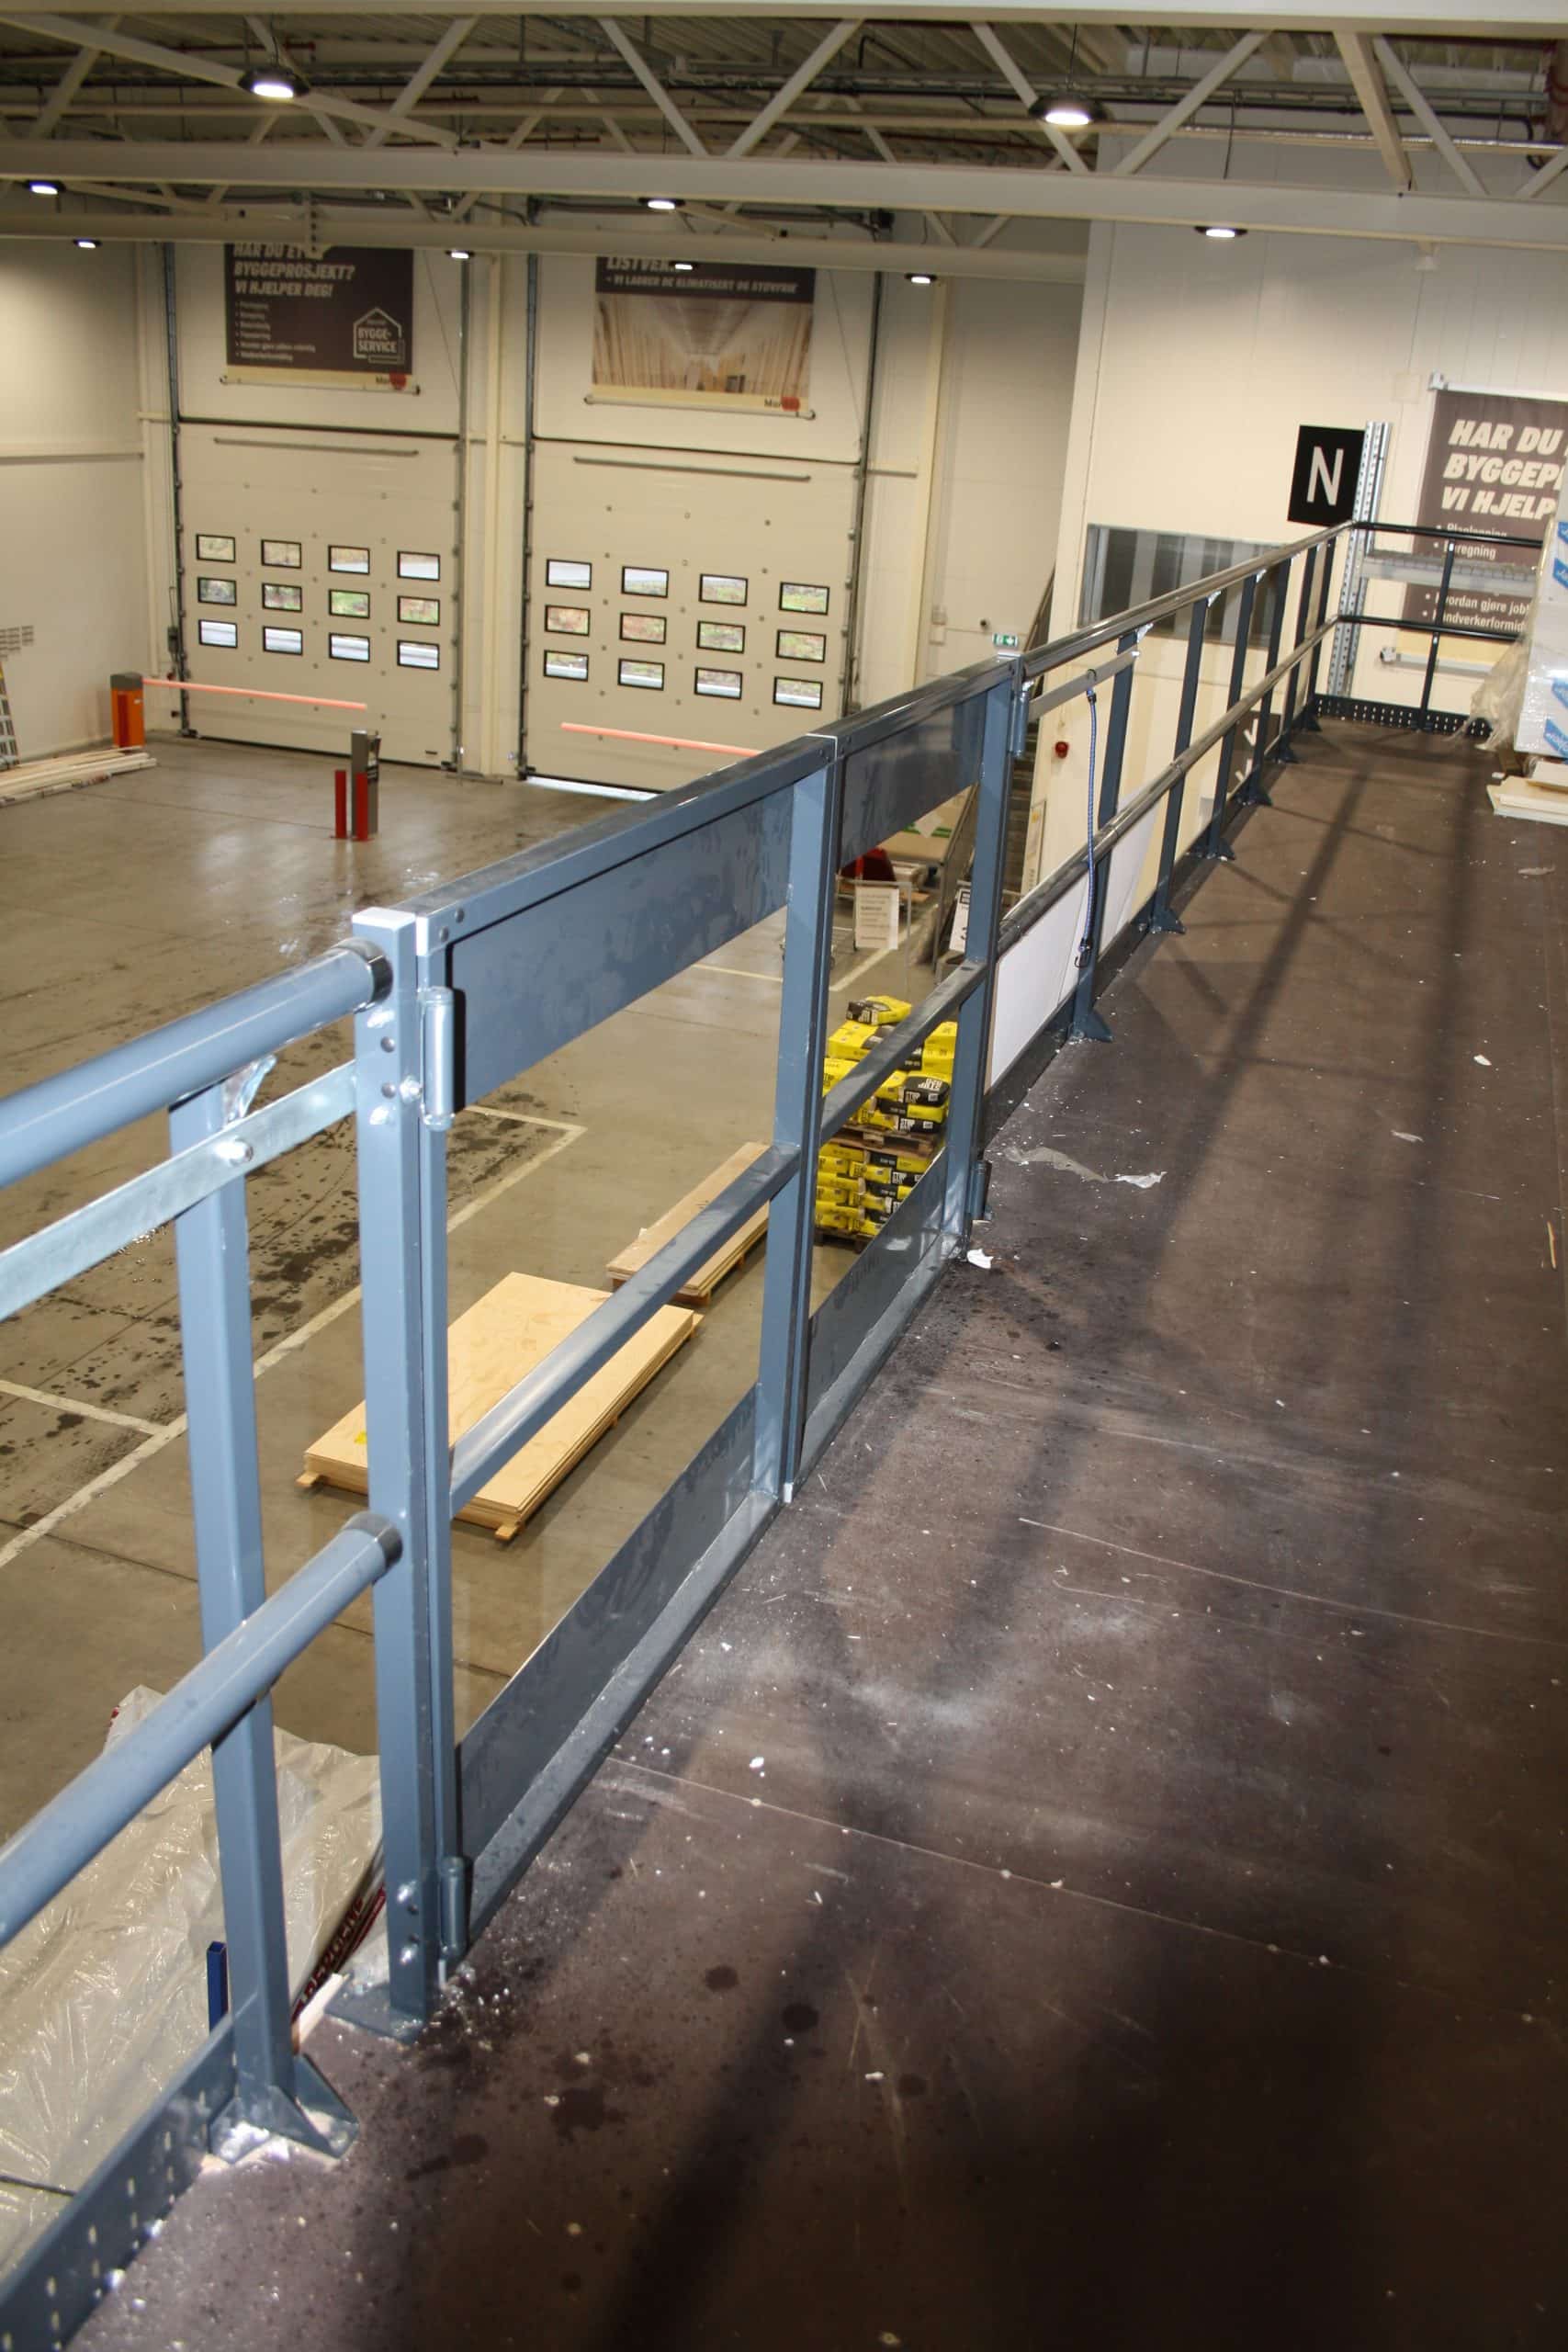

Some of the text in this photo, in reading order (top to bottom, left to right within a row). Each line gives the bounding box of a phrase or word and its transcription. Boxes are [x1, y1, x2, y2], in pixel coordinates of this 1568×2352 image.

[235, 260, 355, 280] BYGGEPROSJEKT?
[357, 340, 398, 354] SERVICE
[1448, 419, 1515, 451] HAR
[1515, 425, 1565, 456] DU
[1306, 446, 1345, 506] N
[1441, 486, 1471, 512] VI
